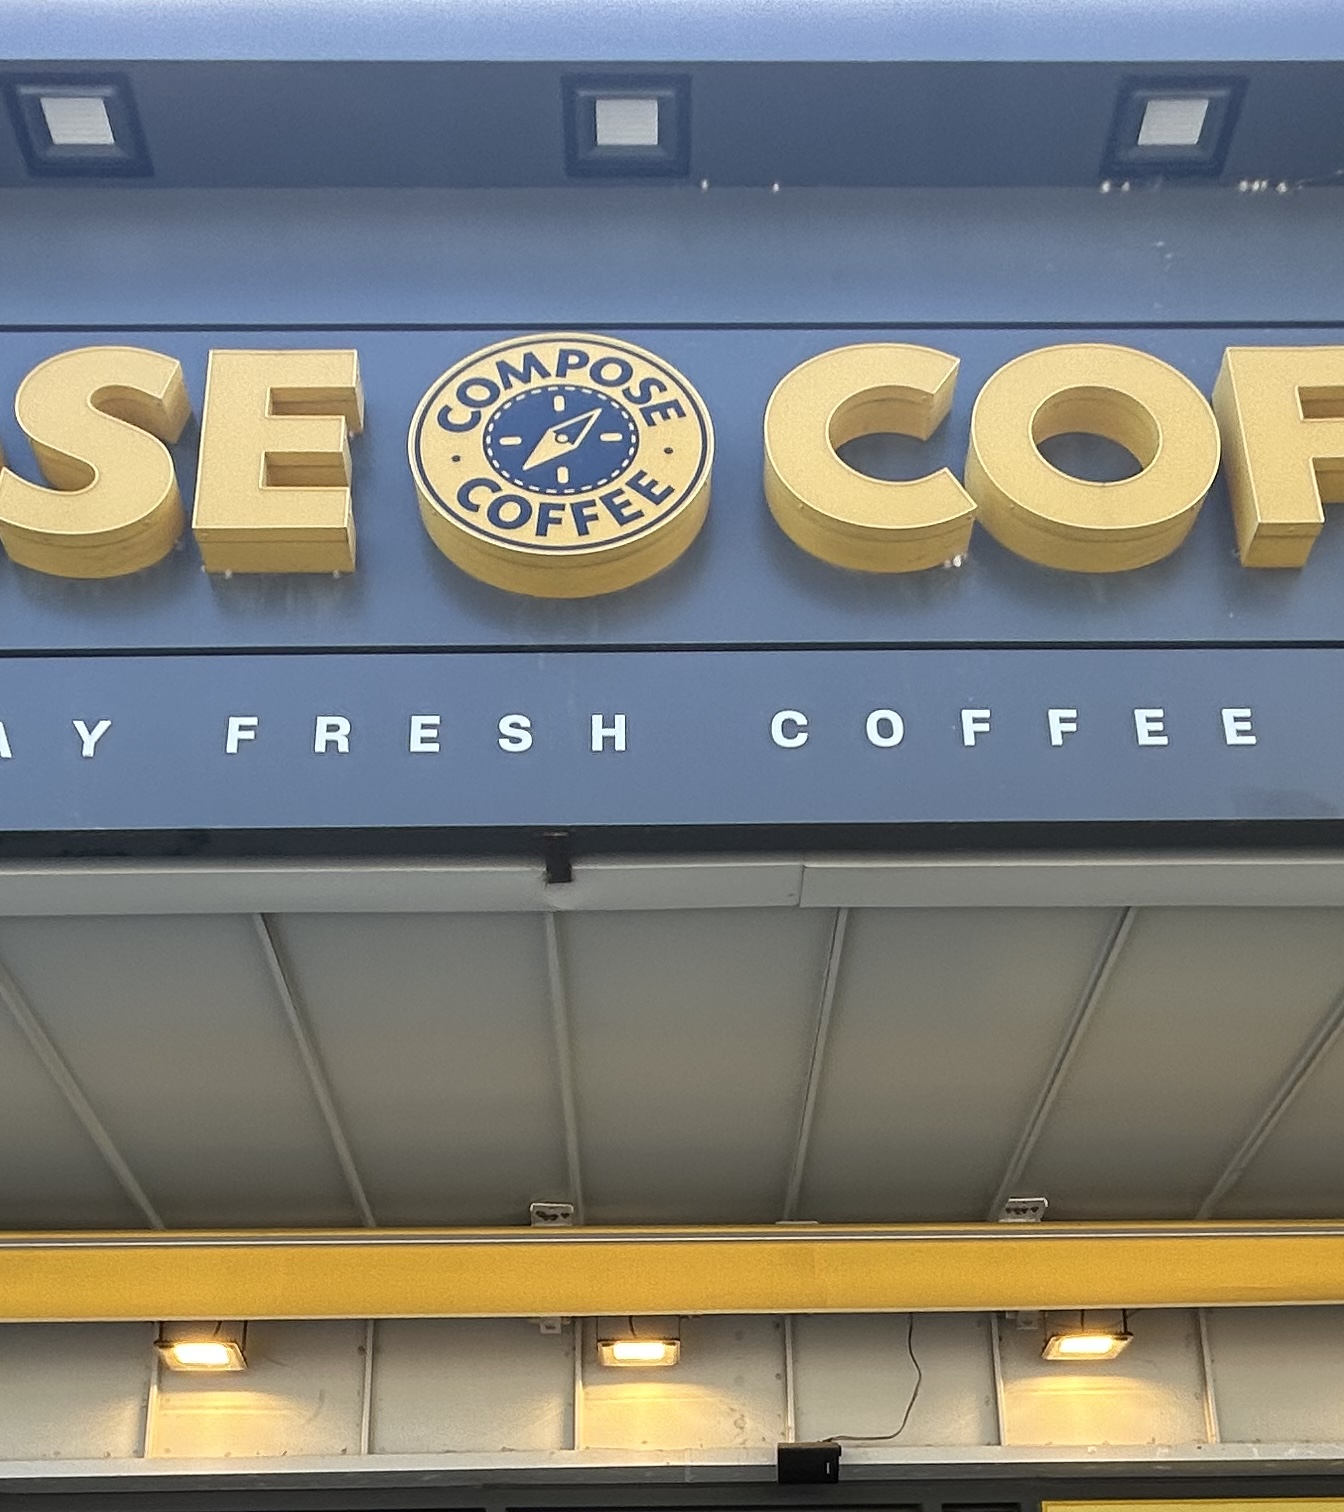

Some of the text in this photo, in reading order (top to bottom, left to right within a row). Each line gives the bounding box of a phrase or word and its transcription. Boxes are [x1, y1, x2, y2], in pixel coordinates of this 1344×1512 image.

[435, 348, 689, 435] COMPOSE
[456, 467, 676, 538] COFFEE
[225, 713, 628, 756] FRESH
[770, 706, 1257, 749] COFFEE
